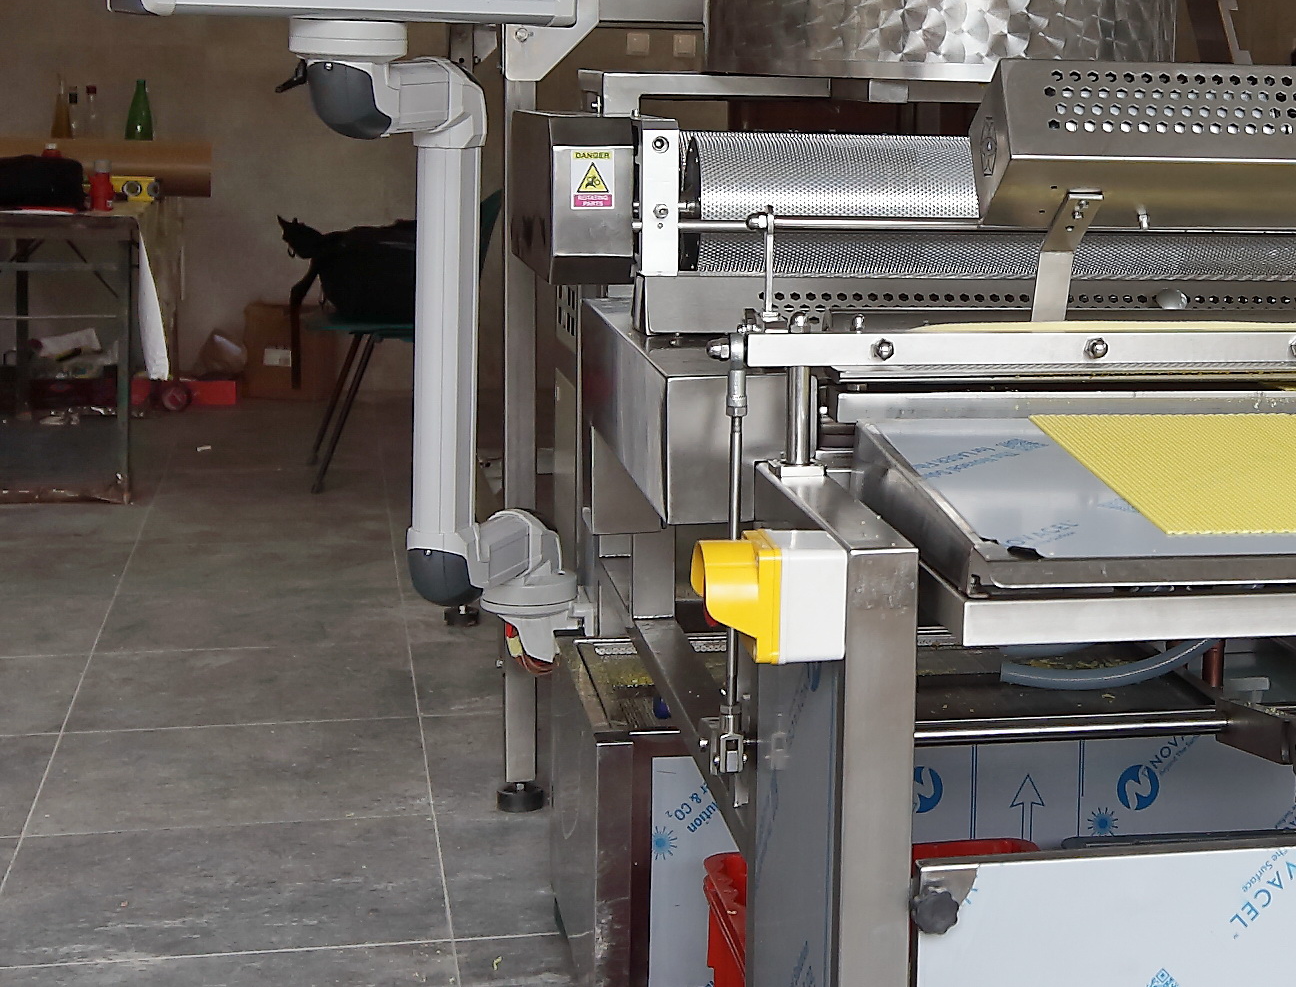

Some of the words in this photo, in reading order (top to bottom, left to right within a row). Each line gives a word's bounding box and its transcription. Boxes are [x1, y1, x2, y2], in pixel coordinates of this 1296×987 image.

[1149, 736, 1184, 769] NOV
[689, 792, 702, 804] &
[1242, 860, 1273, 892] Surface
